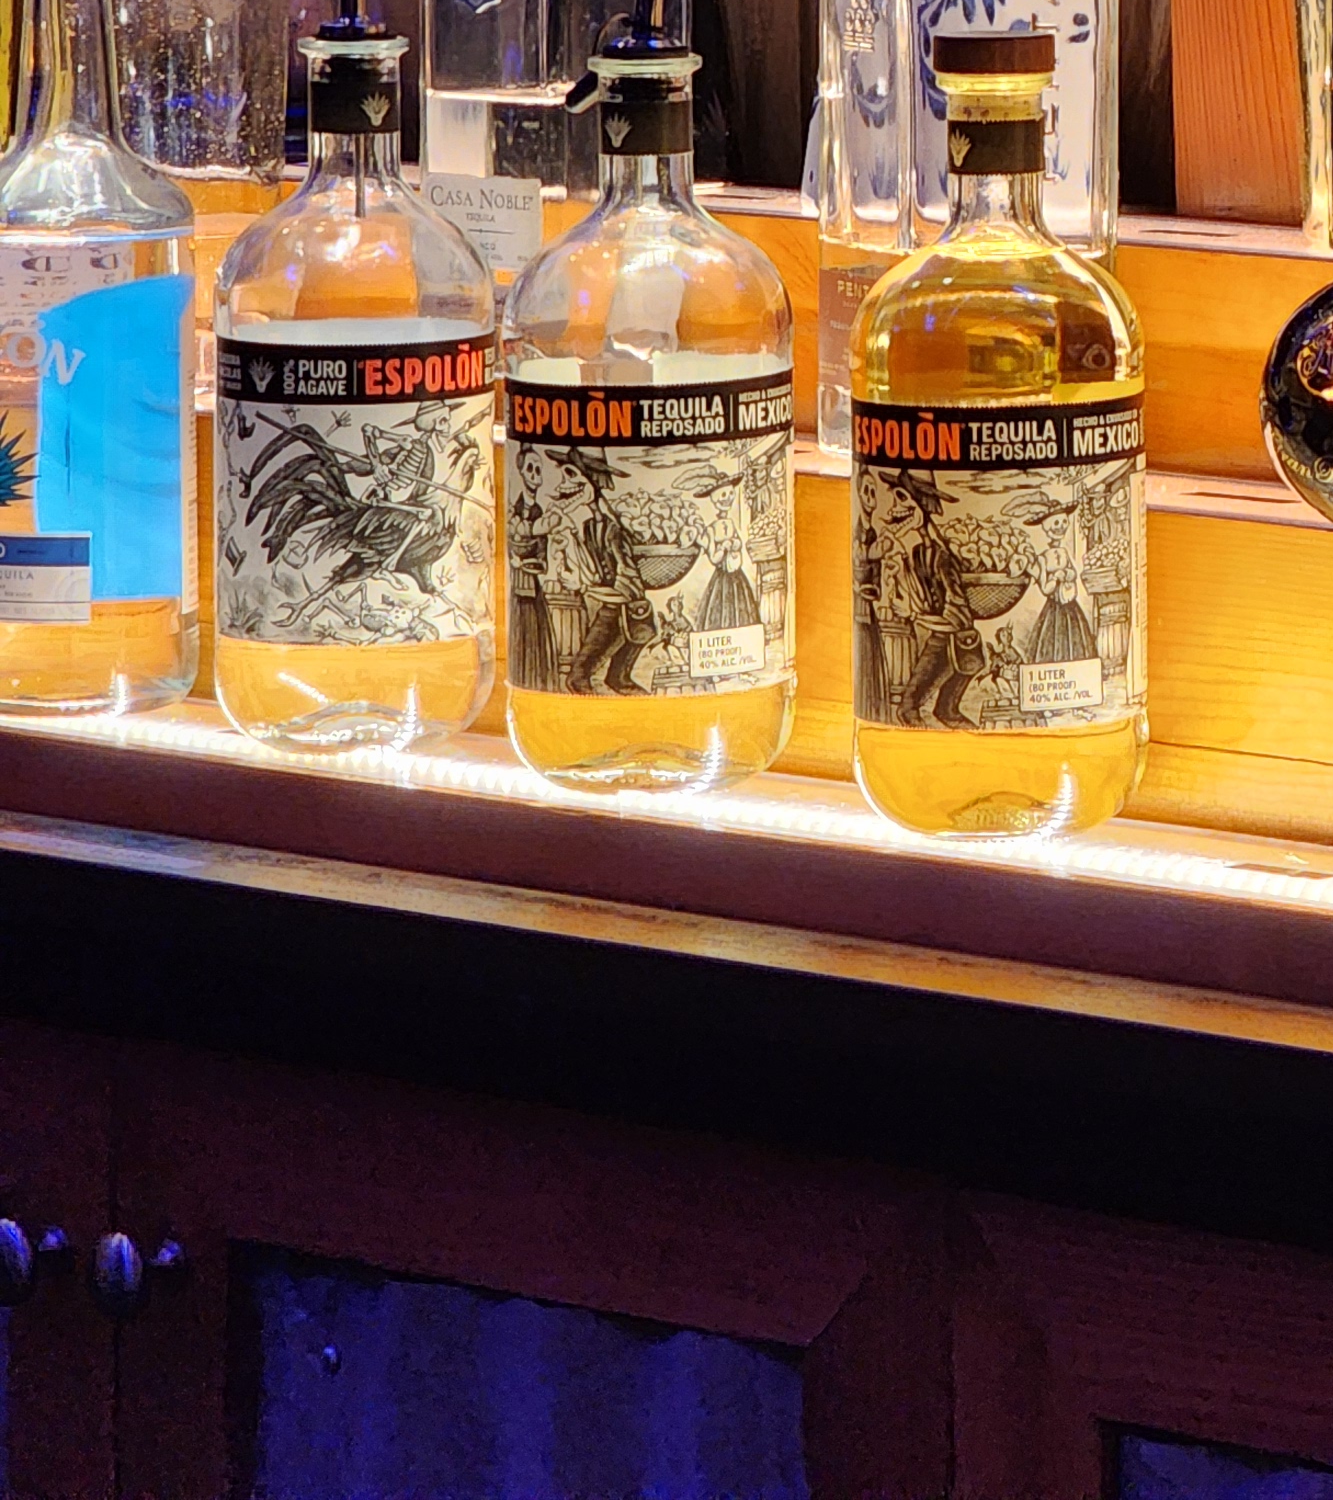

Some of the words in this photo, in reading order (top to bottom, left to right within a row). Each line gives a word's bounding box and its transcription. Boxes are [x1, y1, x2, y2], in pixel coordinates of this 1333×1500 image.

[430, 185, 473, 206] CASA
[479, 188, 531, 211] NOBLE
[283, 358, 296, 395] 100%
[298, 359, 347, 380] PURO
[297, 379, 347, 396] AGAVE
[640, 395, 725, 420] TEQUILA
[640, 417, 725, 438] REPOSADO
[968, 419, 1056, 443] TEQUILA
[1072, 421, 1139, 457] MEXICO
[969, 442, 1058, 462] REPOSADO
[698, 638, 703, 648] 1
[706, 635, 733, 647] LITER
[698, 659, 719, 670] 40%
[1028, 671, 1034, 681] 1
[1037, 668, 1066, 681] LITER
[1028, 692, 1051, 704] 40%
